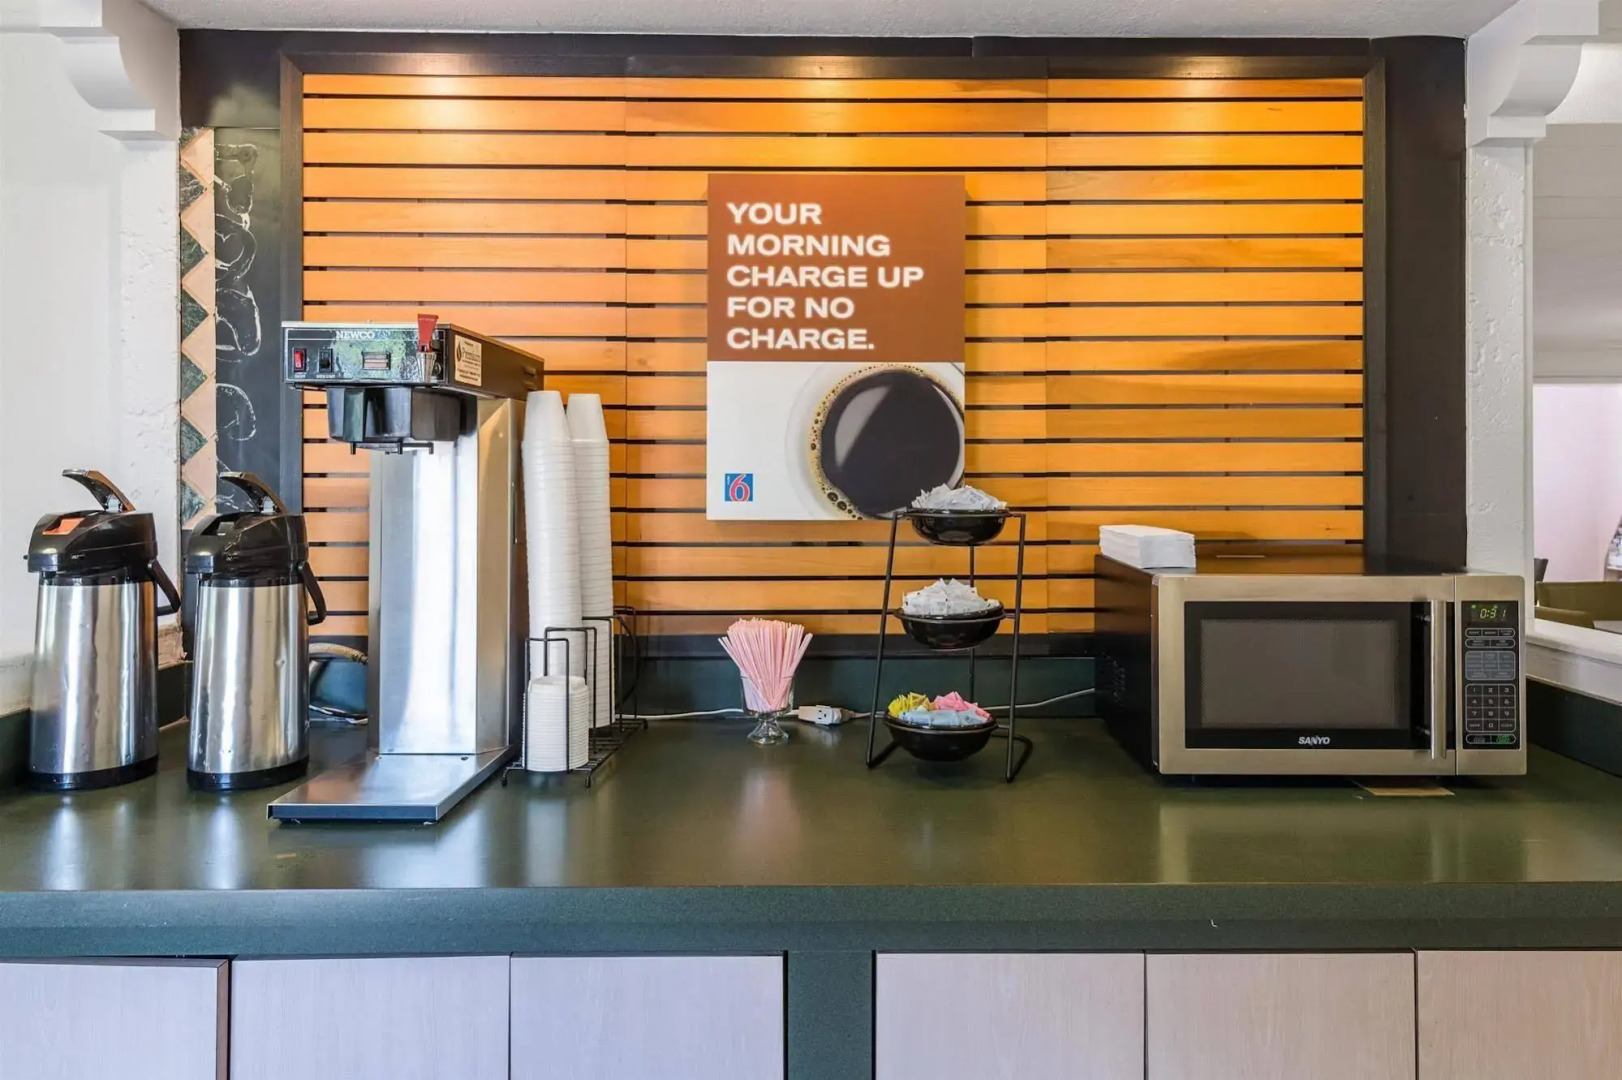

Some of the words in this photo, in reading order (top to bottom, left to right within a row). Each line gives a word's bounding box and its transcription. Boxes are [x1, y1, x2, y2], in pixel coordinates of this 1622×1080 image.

[726, 202, 822, 225] YOUR
[727, 234, 891, 257] MORNING
[726, 265, 868, 288] CHARGE
[877, 266, 925, 288] UP
[727, 296, 796, 319] FOR
[804, 296, 855, 319] NO
[335, 330, 375, 339] NEWCO
[726, 327, 875, 350] CHARGE.
[729, 473, 750, 502] 6
[1298, 736, 1331, 745] SANYO
